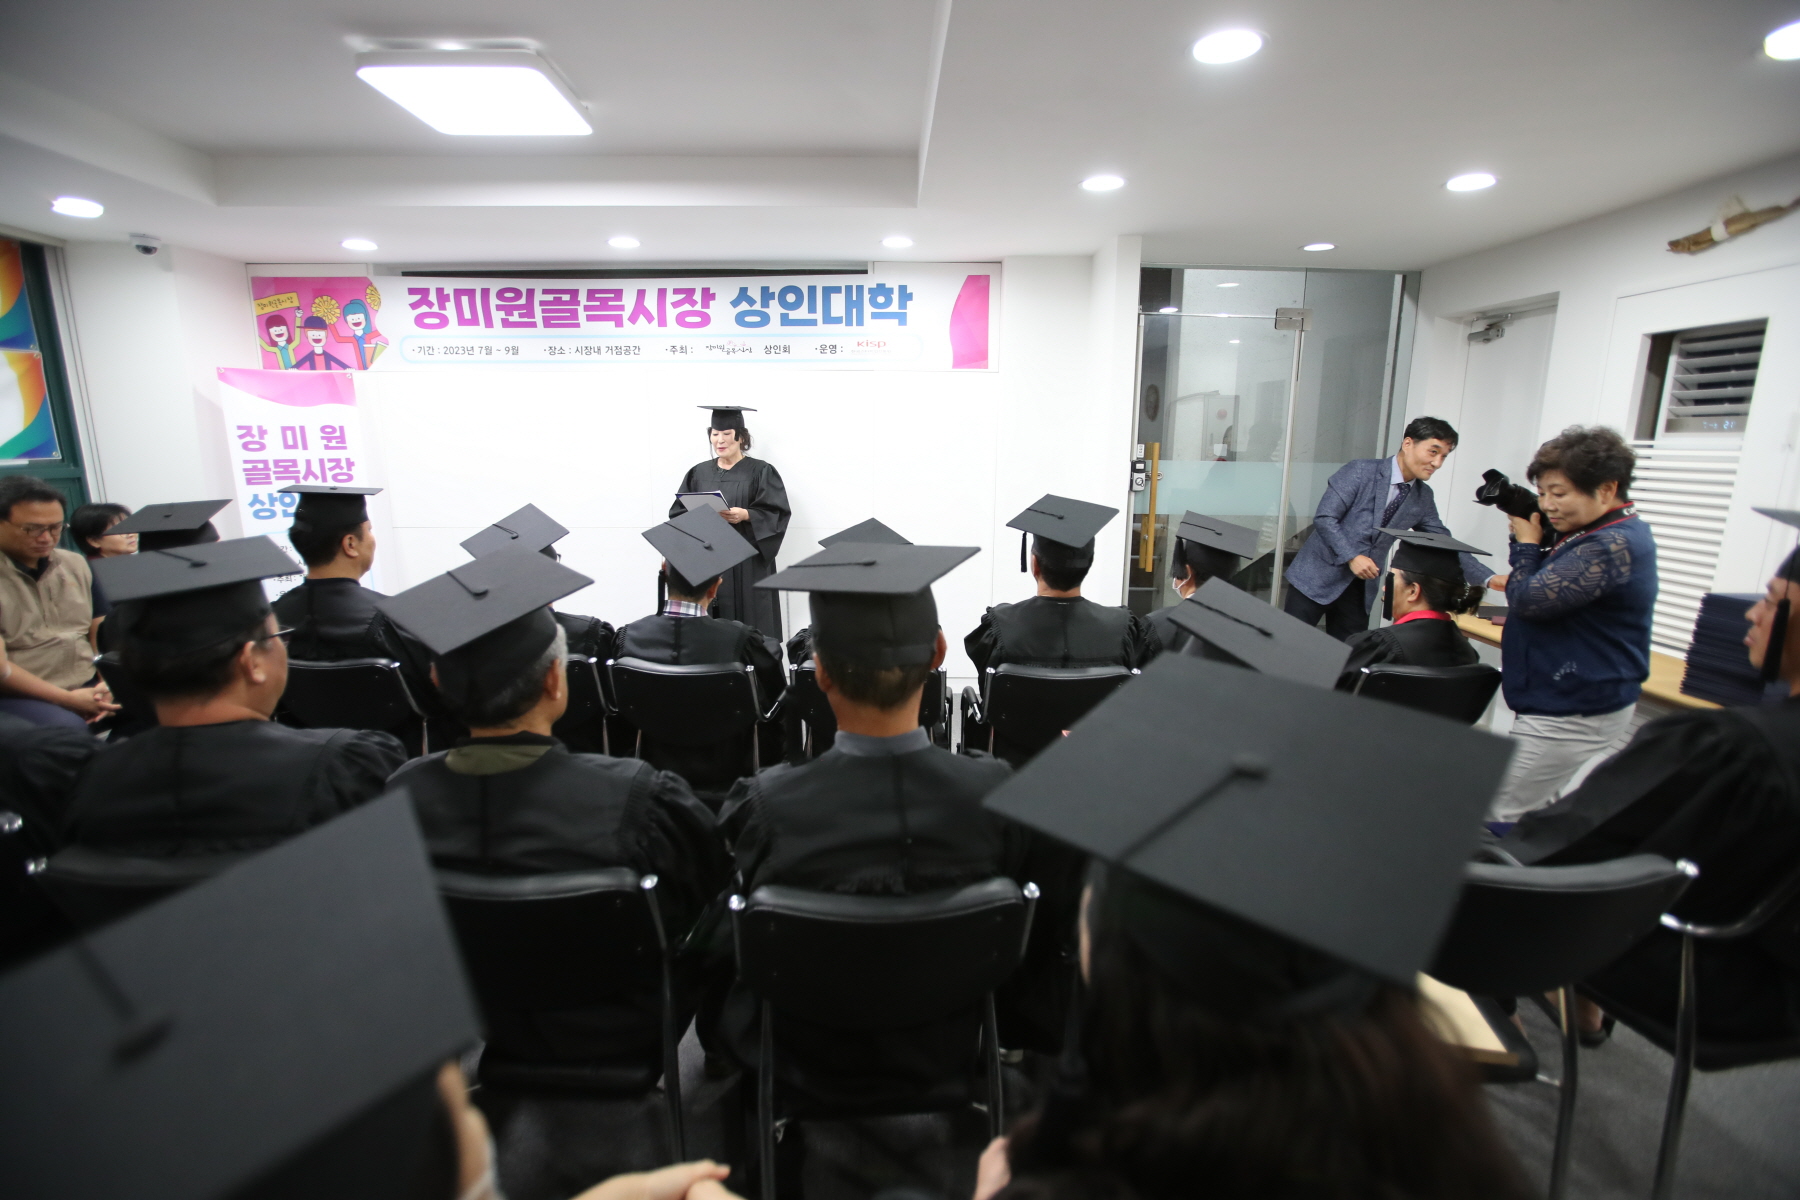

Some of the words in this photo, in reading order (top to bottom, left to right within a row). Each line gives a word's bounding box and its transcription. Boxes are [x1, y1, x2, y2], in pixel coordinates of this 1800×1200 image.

[407, 286, 716, 330] 장미원골목시장
[729, 283, 913, 329] 상인대학
[443, 345, 475, 356] 2023년
[478, 345, 493, 356] 7월
[504, 345, 519, 356] 9월
[574, 345, 602, 356] 시장내
[605, 345, 641, 356] 거점공간
[763, 344, 791, 355] 상인회
[242, 457, 355, 486] 골목시장
[248, 493, 296, 520] 상인
